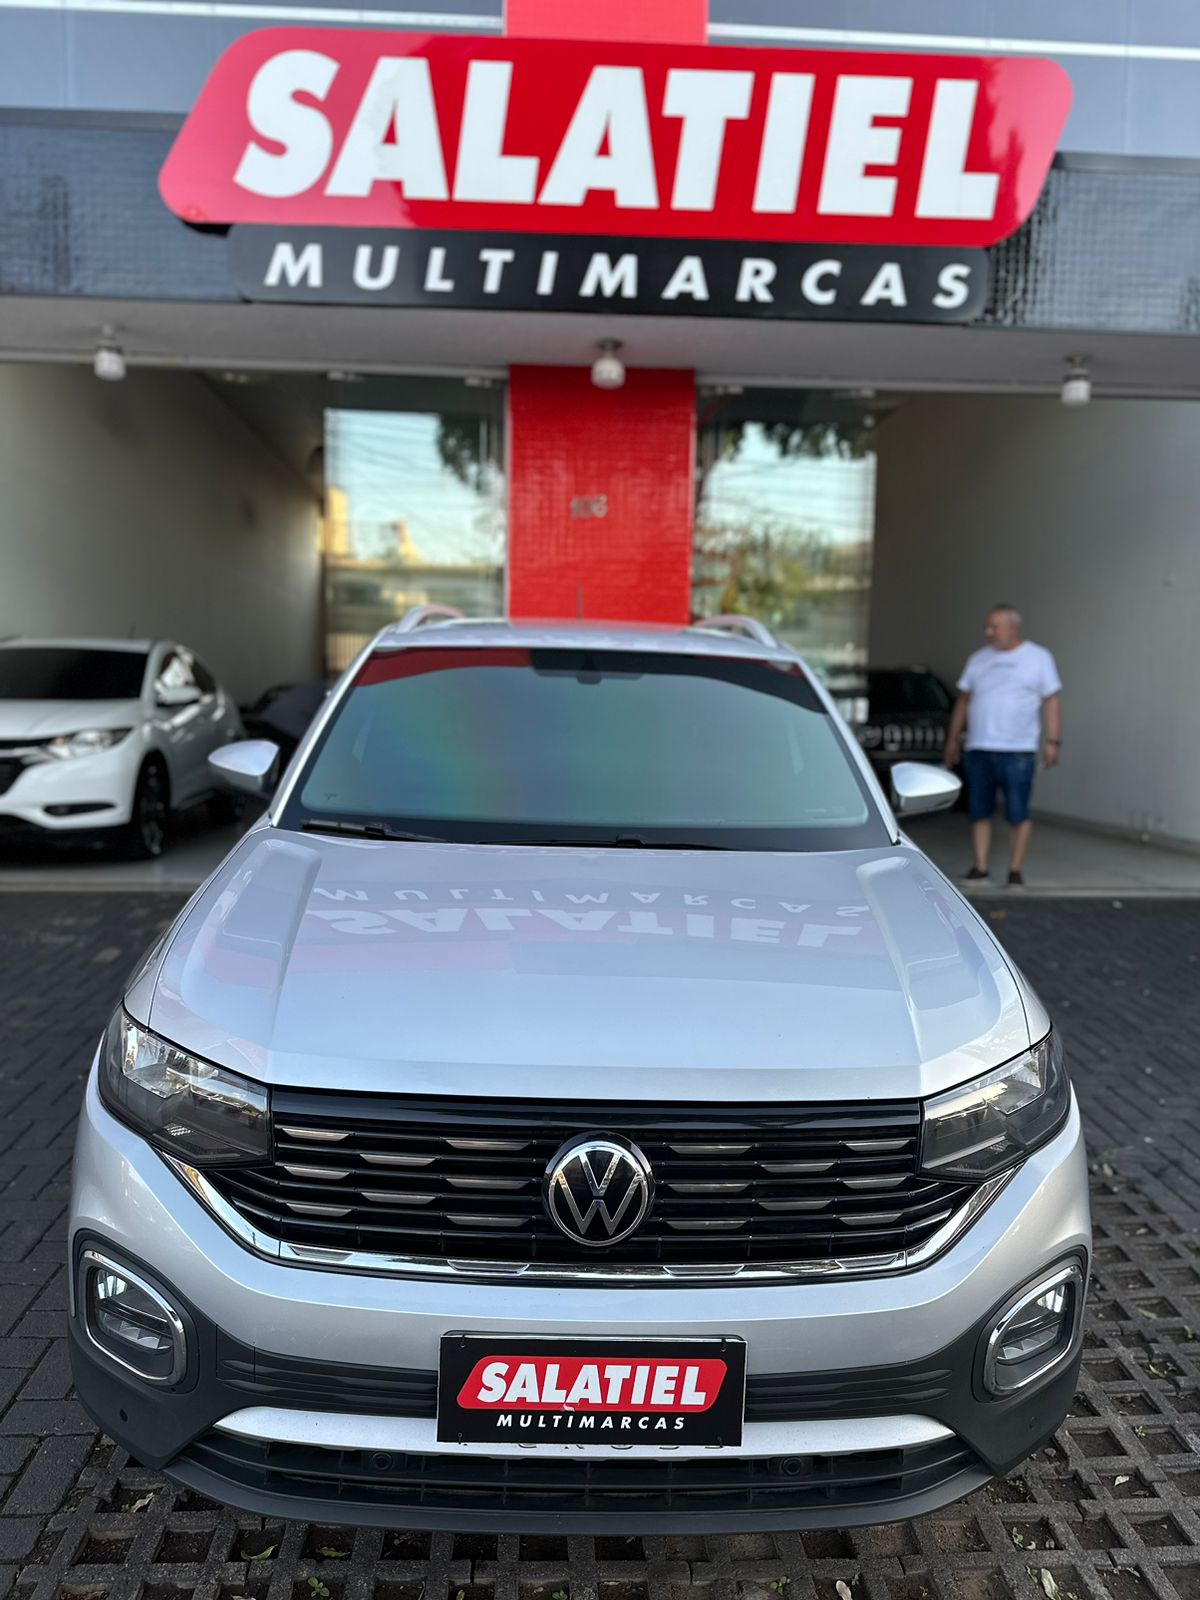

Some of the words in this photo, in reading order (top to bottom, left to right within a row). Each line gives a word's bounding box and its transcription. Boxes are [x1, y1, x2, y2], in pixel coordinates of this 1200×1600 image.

[234, 50, 999, 220] SALATIEL
[263, 242, 971, 309] MULTIMARCAS
[476, 1361, 707, 1406] SALATIEL
[496, 1414, 685, 1430] MULTIMARCAS
